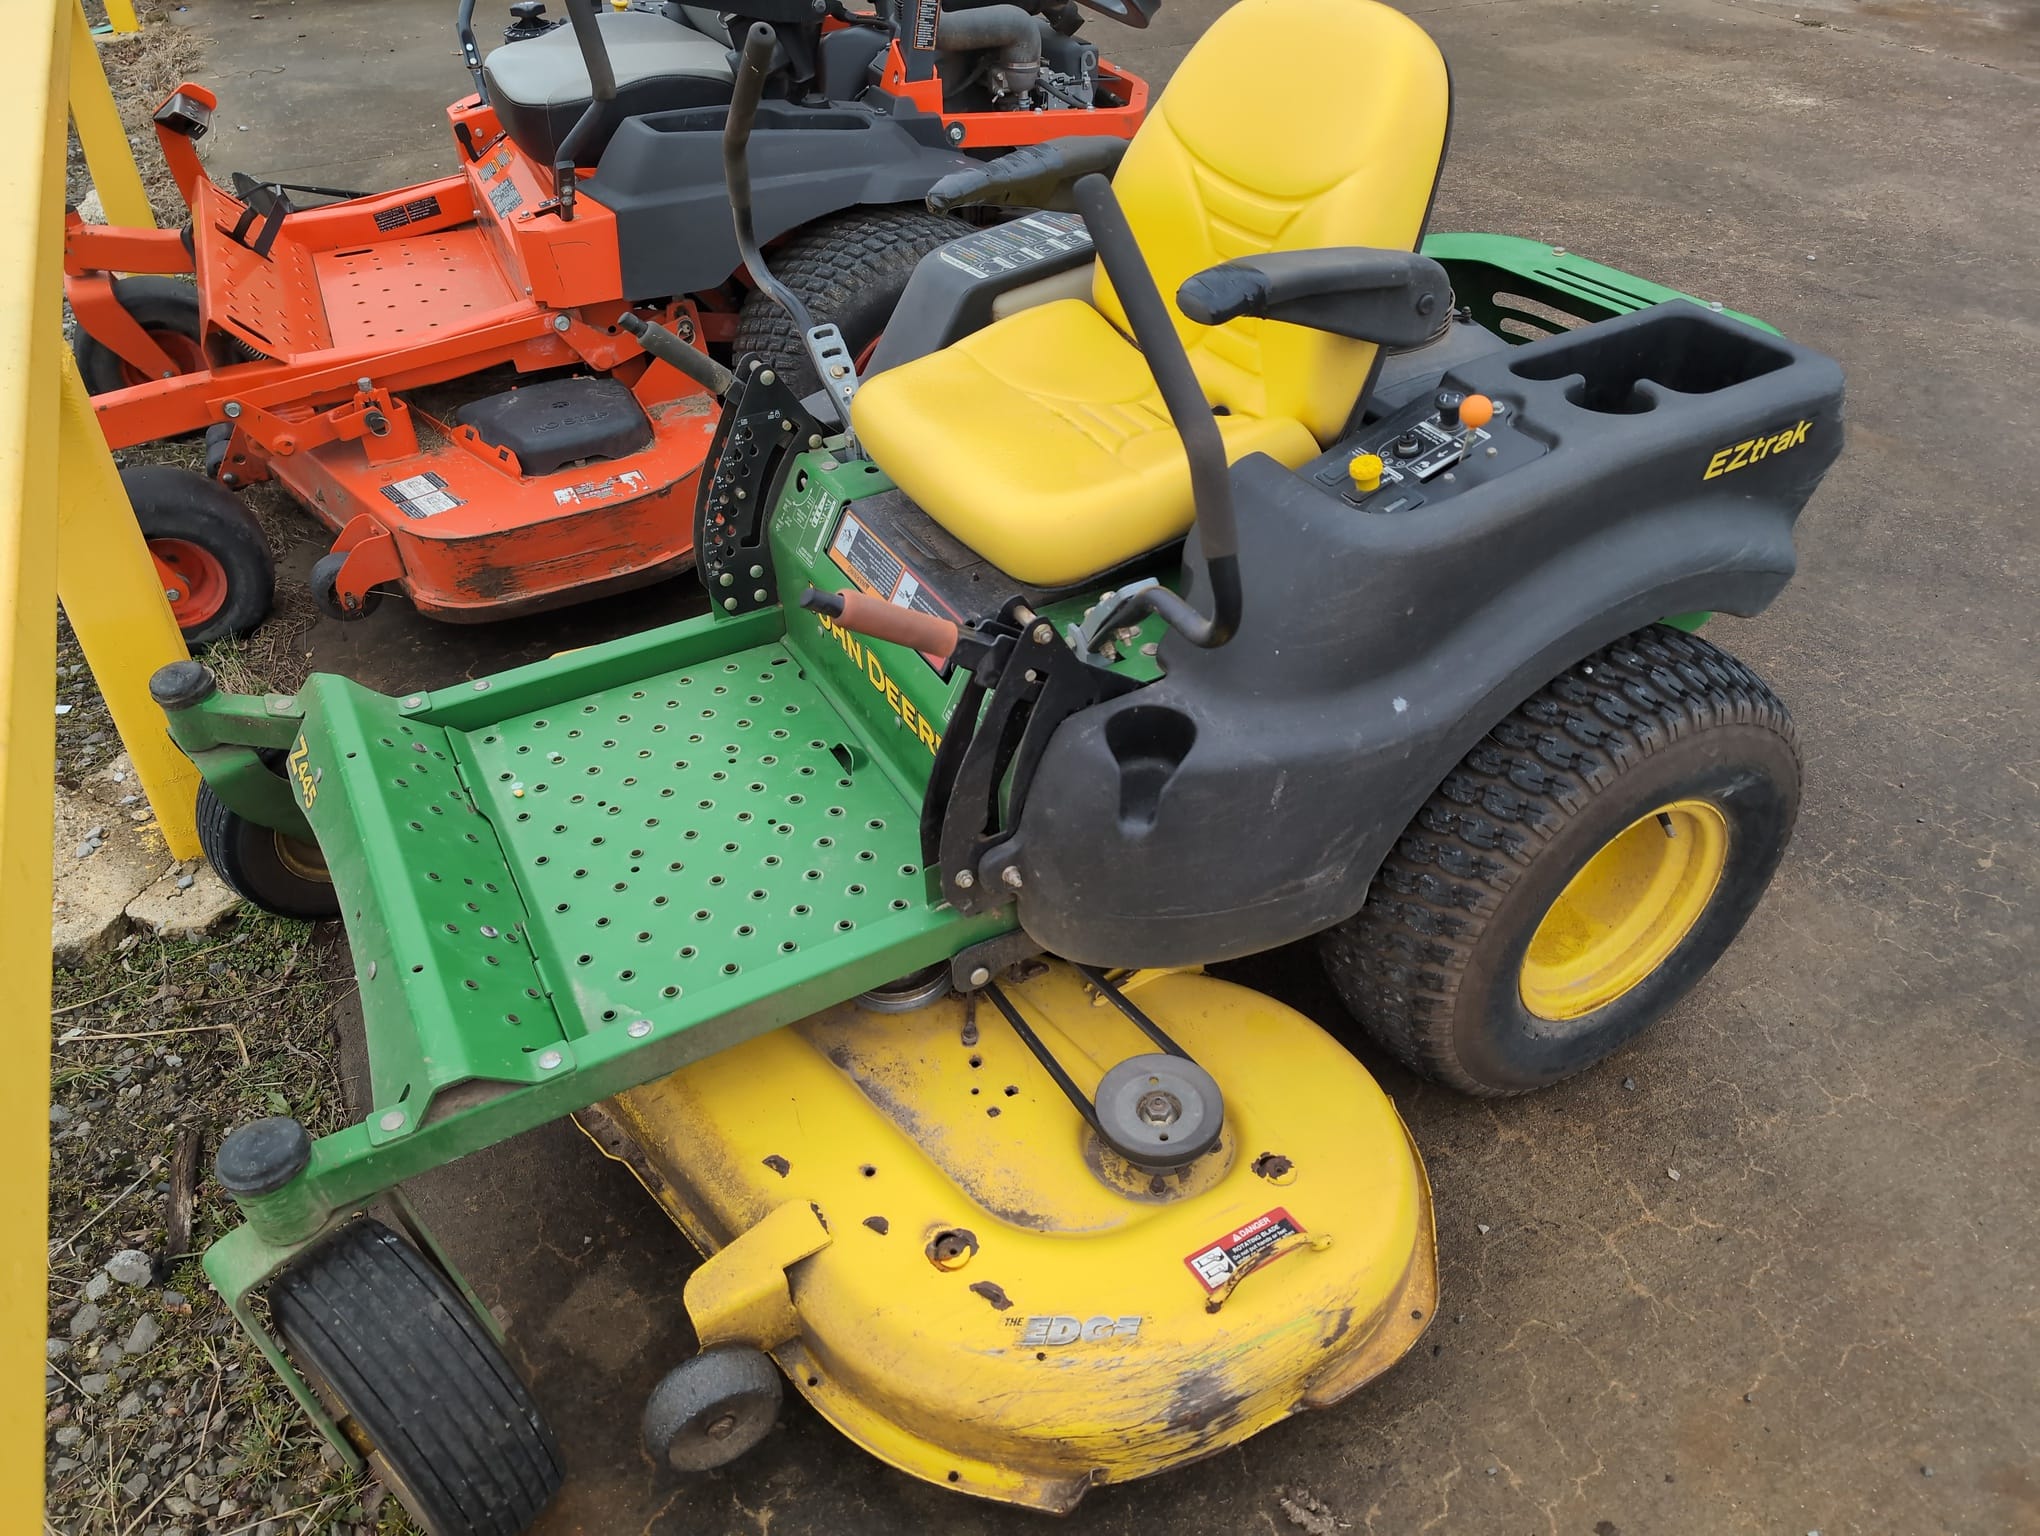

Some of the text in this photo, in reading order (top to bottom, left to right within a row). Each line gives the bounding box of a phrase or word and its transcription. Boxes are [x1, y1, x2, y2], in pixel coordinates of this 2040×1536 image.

[1703, 420, 1813, 481] EZtrak
[289, 733, 318, 809] Z445
[1232, 1234, 1262, 1253] ROTATING
[1260, 1224, 1280, 1237] BLADE
[1239, 1216, 1271, 1237] DANGER
[1241, 1249, 1250, 1257] not
[1004, 1315, 1142, 1346] THE EDGE
